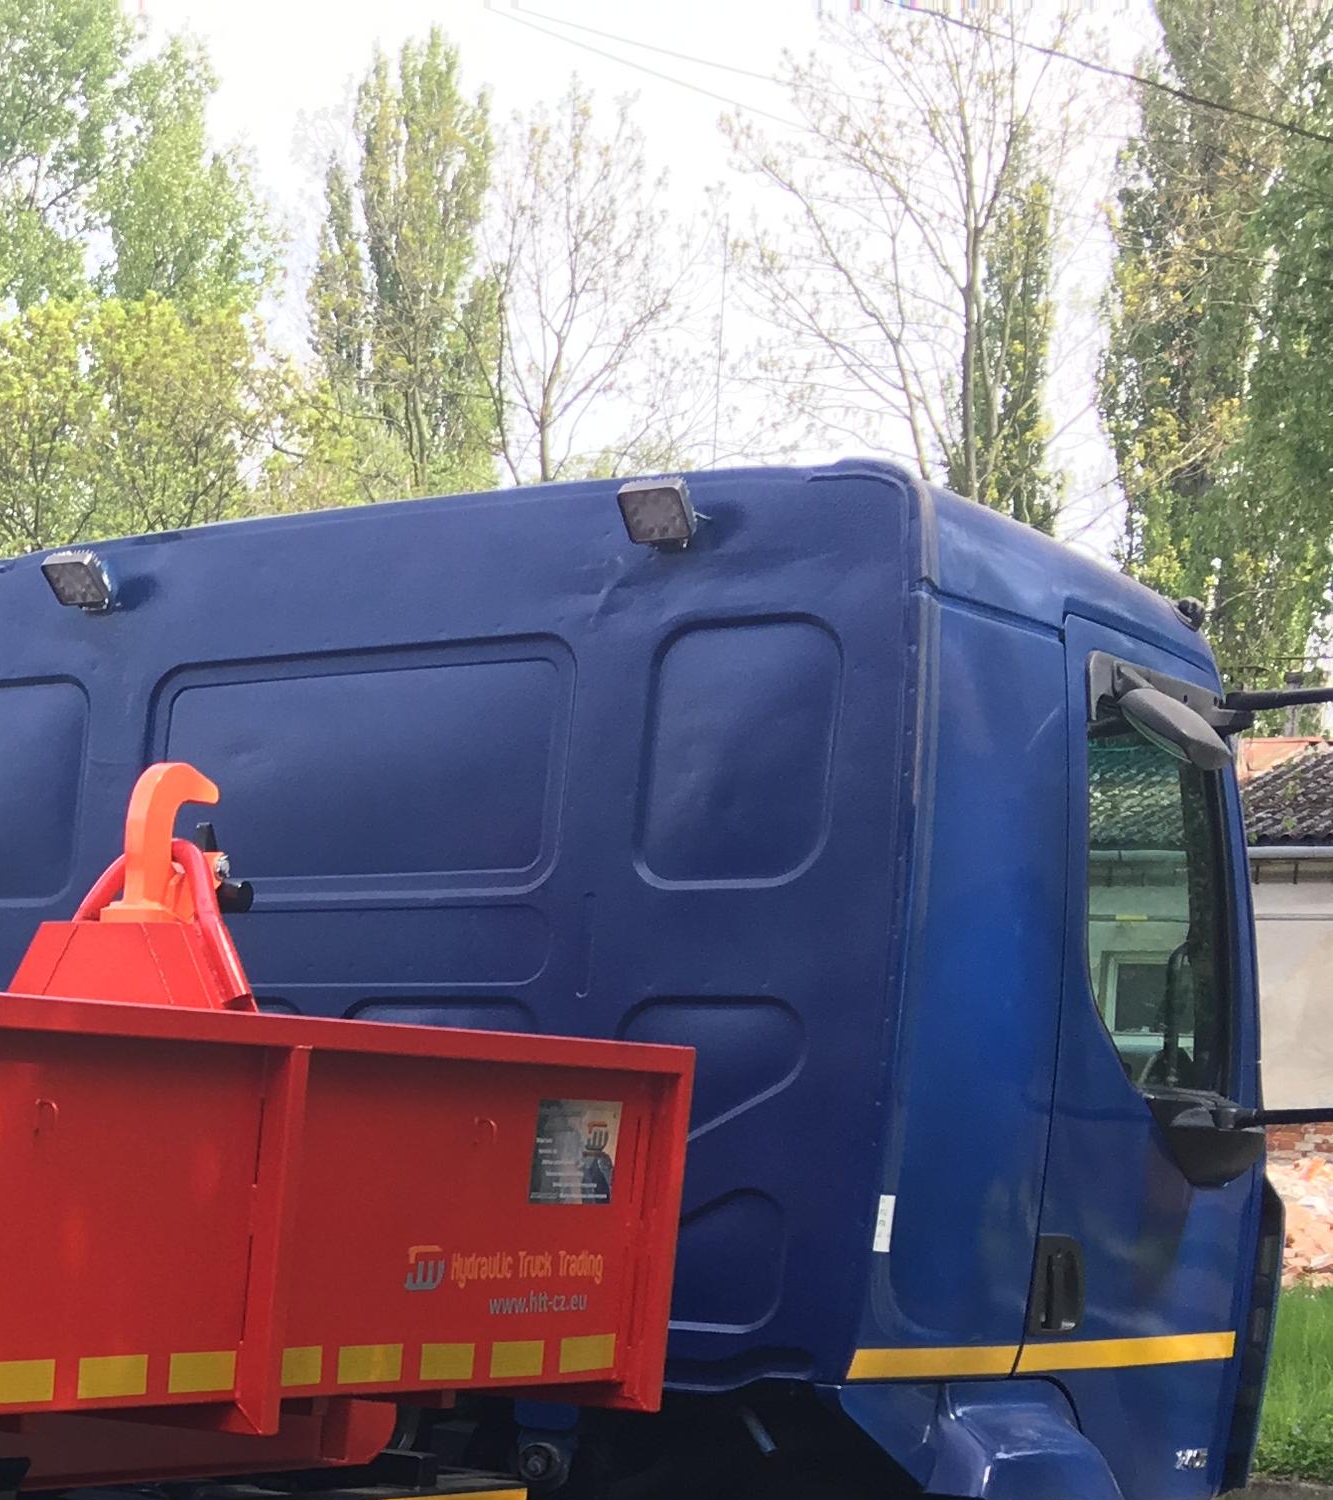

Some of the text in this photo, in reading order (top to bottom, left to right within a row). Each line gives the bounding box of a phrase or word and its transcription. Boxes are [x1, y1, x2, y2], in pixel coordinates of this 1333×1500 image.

[451, 1250, 604, 1289] Hydraulic Truck Trading
[489, 1291, 588, 1315] www.htt-cz.eu
